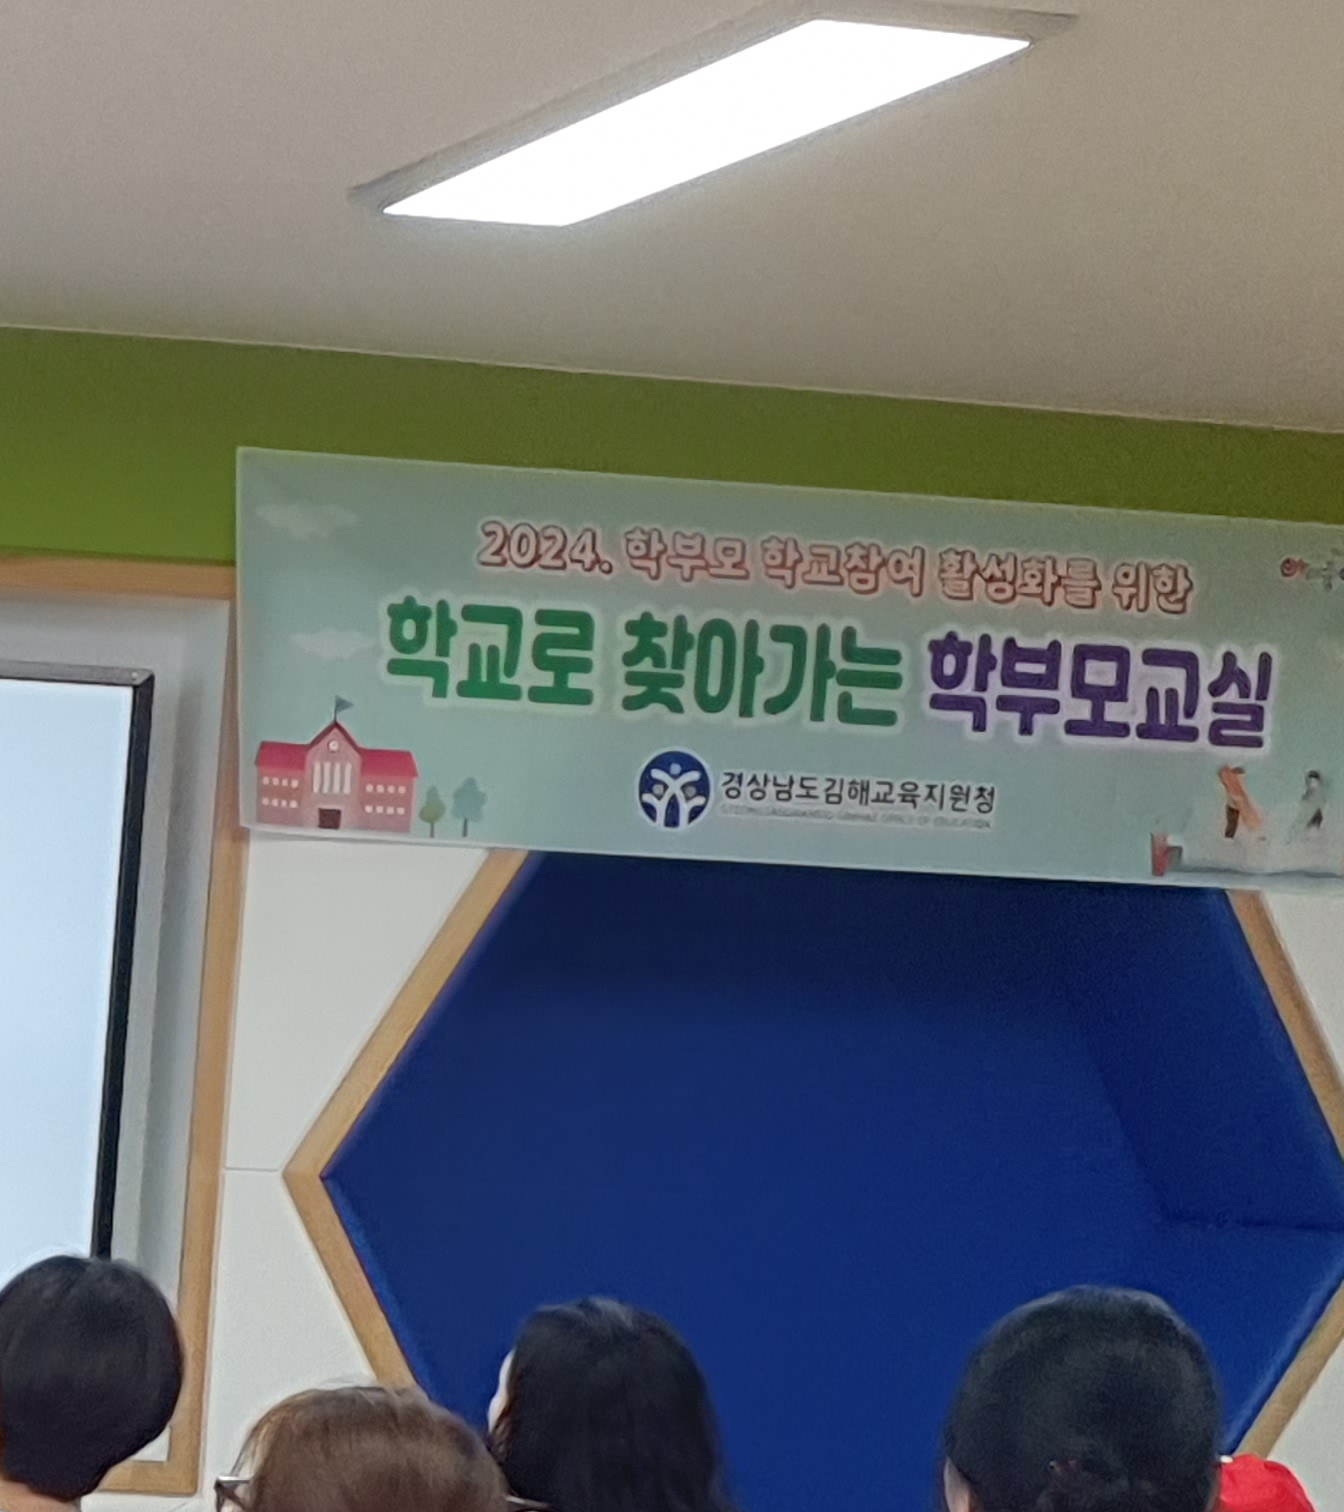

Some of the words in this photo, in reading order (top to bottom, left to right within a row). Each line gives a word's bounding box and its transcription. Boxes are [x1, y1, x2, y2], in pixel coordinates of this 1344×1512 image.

[478, 520, 613, 576] 2024.
[623, 526, 750, 582] 학부모
[763, 535, 926, 598] 학교참여
[938, 547, 1102, 609] 활성화를
[1113, 561, 1194, 614] 위한
[386, 595, 595, 706] 학교로
[621, 611, 904, 727] 찾아가는
[927, 631, 1273, 748] 학부모교실
[720, 771, 996, 815] 경상남도김해교육지원청
